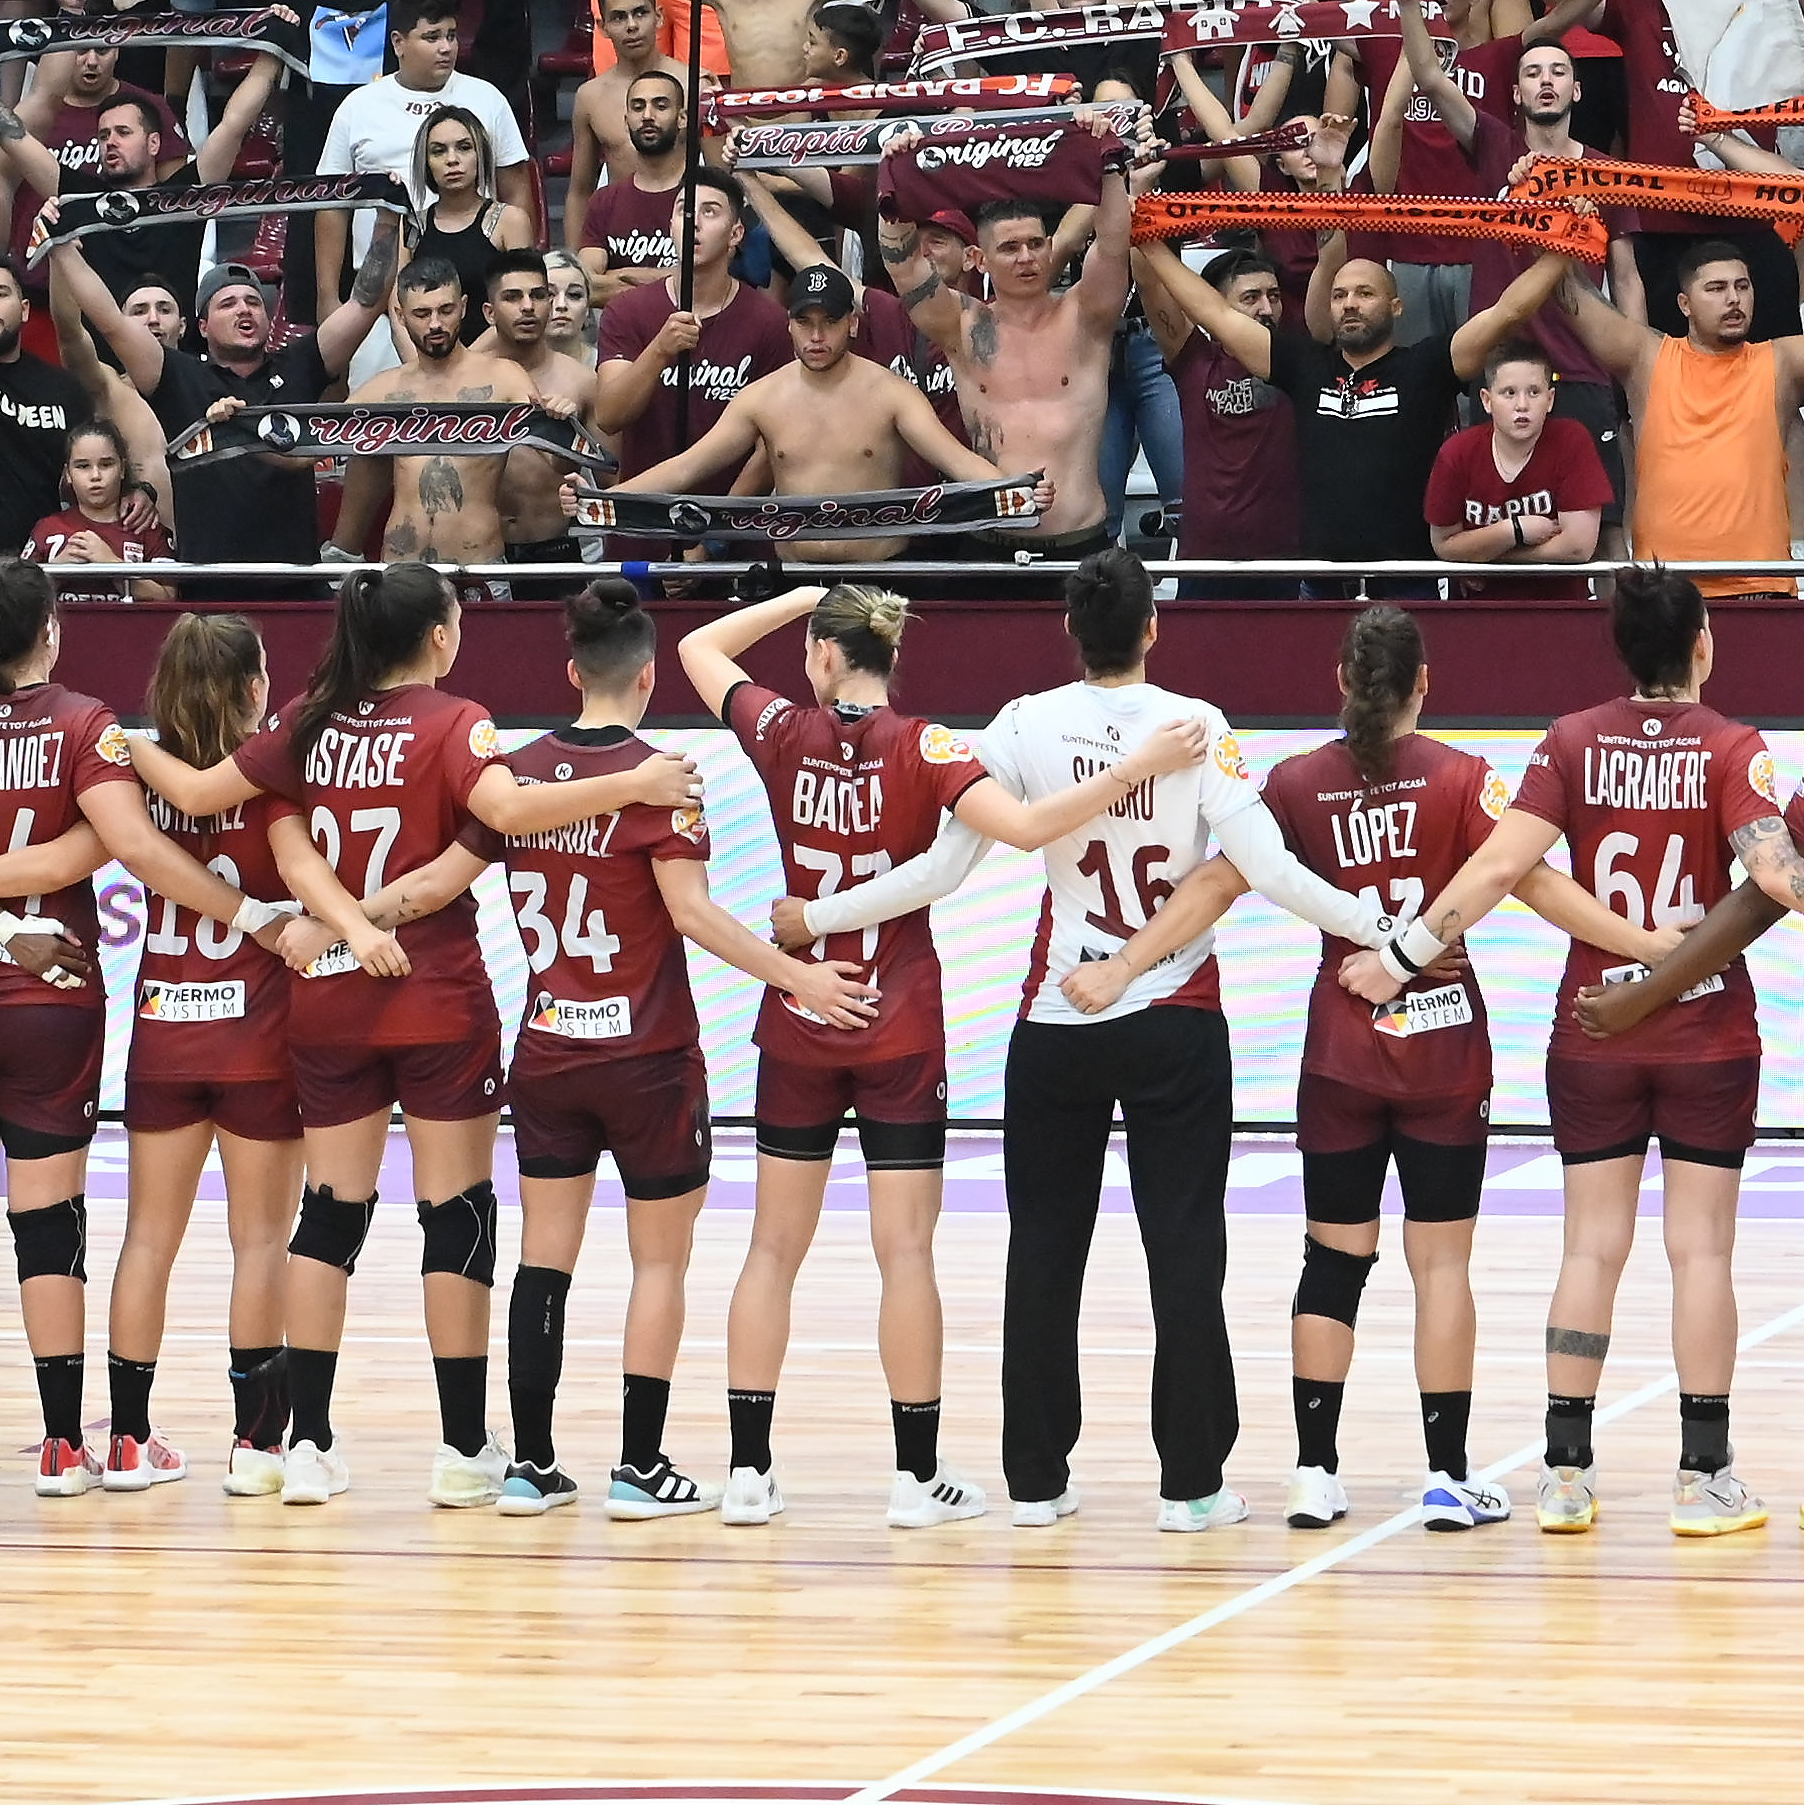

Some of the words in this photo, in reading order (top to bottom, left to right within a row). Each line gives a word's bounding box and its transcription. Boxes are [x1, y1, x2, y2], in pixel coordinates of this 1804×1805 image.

[947, 11, 1067, 56] F.C.
[739, 121, 879, 166] Rapid
[1007, 154, 1047, 169] 1923
[1527, 162, 1667, 197] OFFICIAL
[1206, 388, 1252, 405] NORTH
[1226, 377, 1251, 392] THE
[1217, 401, 1252, 416] FACE
[1464, 490, 1555, 529] RAPID
[1584, 746, 1711, 811] LACRABERE
[1330, 797, 1419, 869] LÓPEZ
[310, 806, 401, 899] 27
[1077, 839, 1176, 941] 16
[1595, 830, 1706, 934] 64
[509, 870, 621, 974] 34
[163, 984, 236, 1003] THERMO
[1403, 988, 1462, 1014] HERMO
[158, 1001, 236, 1020] SYSTEM
[553, 1002, 621, 1022] ERMO
[1403, 1006, 1467, 1032] YSTEM
[555, 1017, 624, 1036] SSTEM
